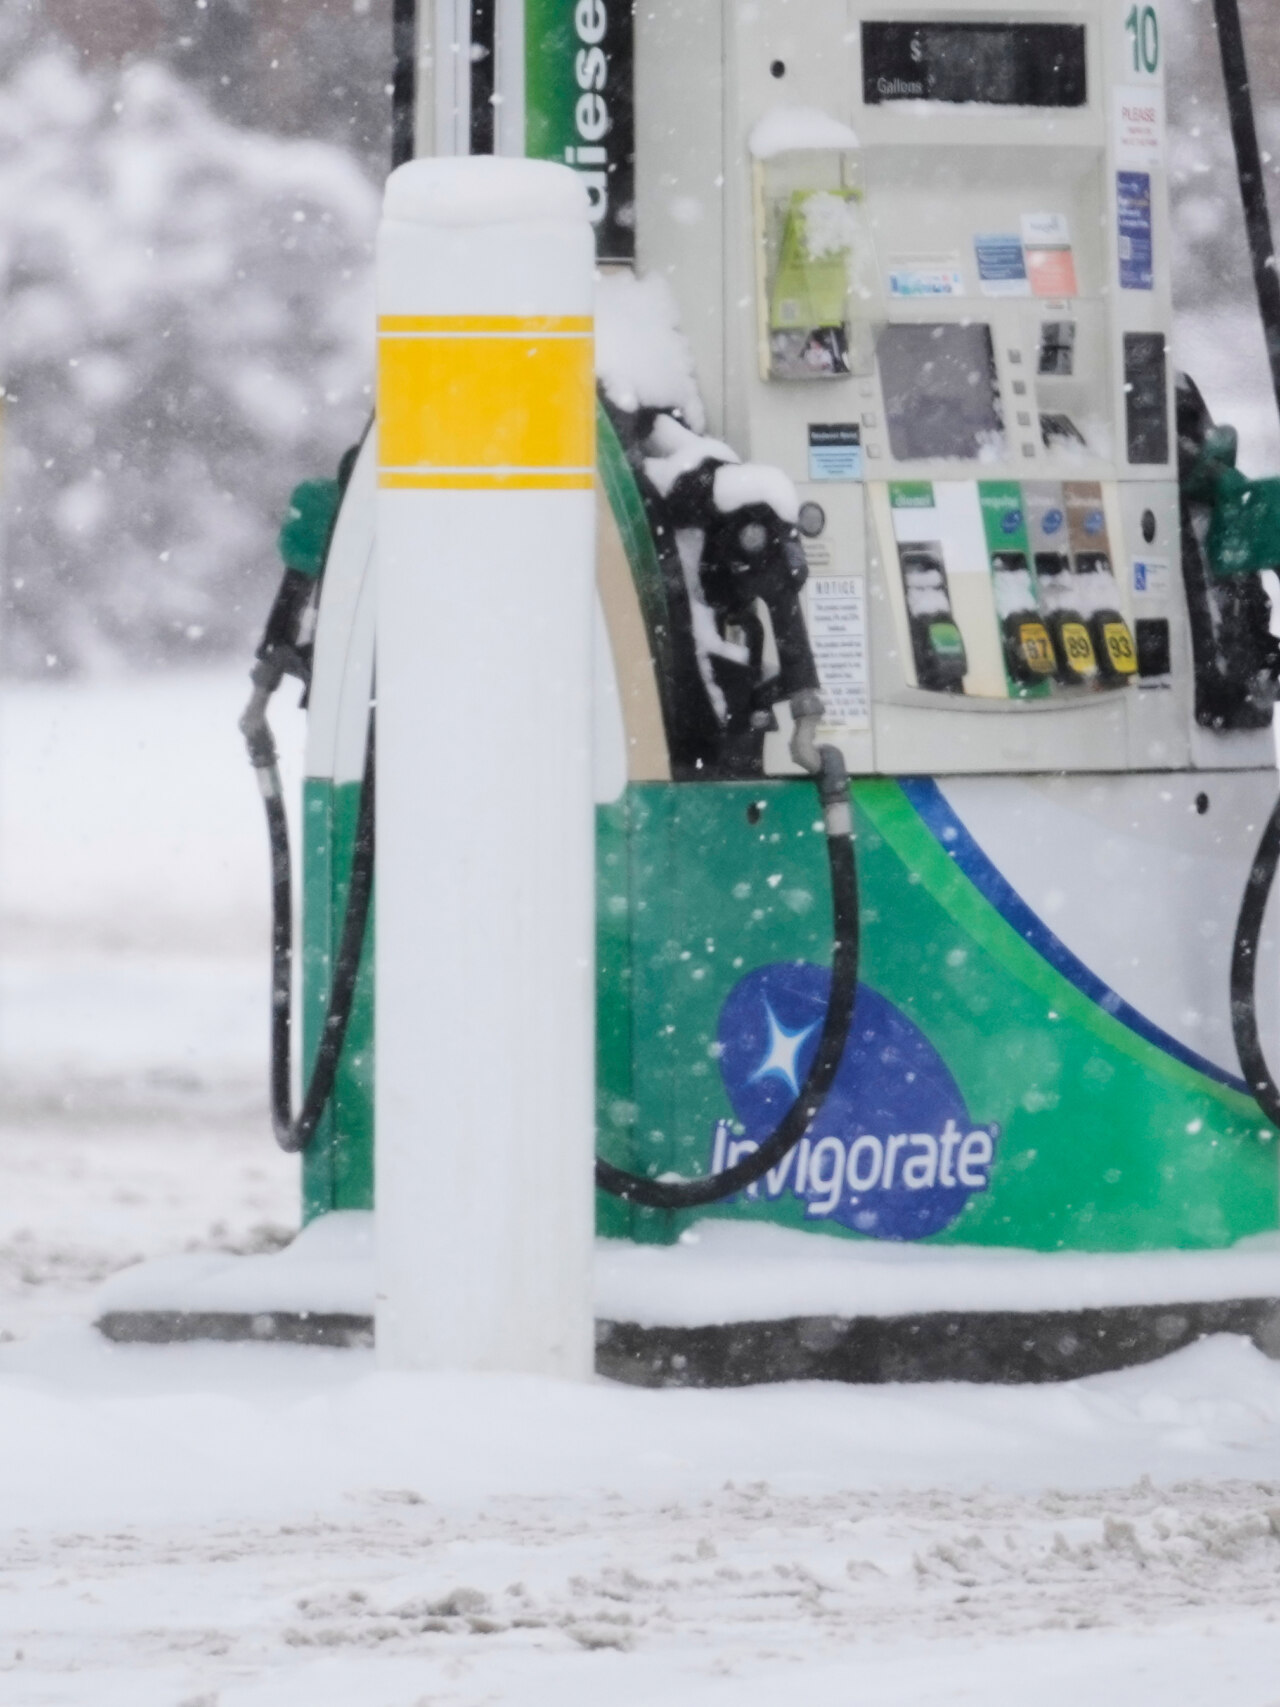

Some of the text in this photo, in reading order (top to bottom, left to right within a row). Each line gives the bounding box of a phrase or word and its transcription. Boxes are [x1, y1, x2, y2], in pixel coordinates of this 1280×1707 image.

[1124, 4, 1158, 73] 10
[877, 77, 923, 95] Gallons
[1121, 106, 1156, 123] PLEASE
[815, 581, 856, 595] NOTICE
[1067, 636, 1090, 658] 89
[1109, 636, 1132, 658] 93
